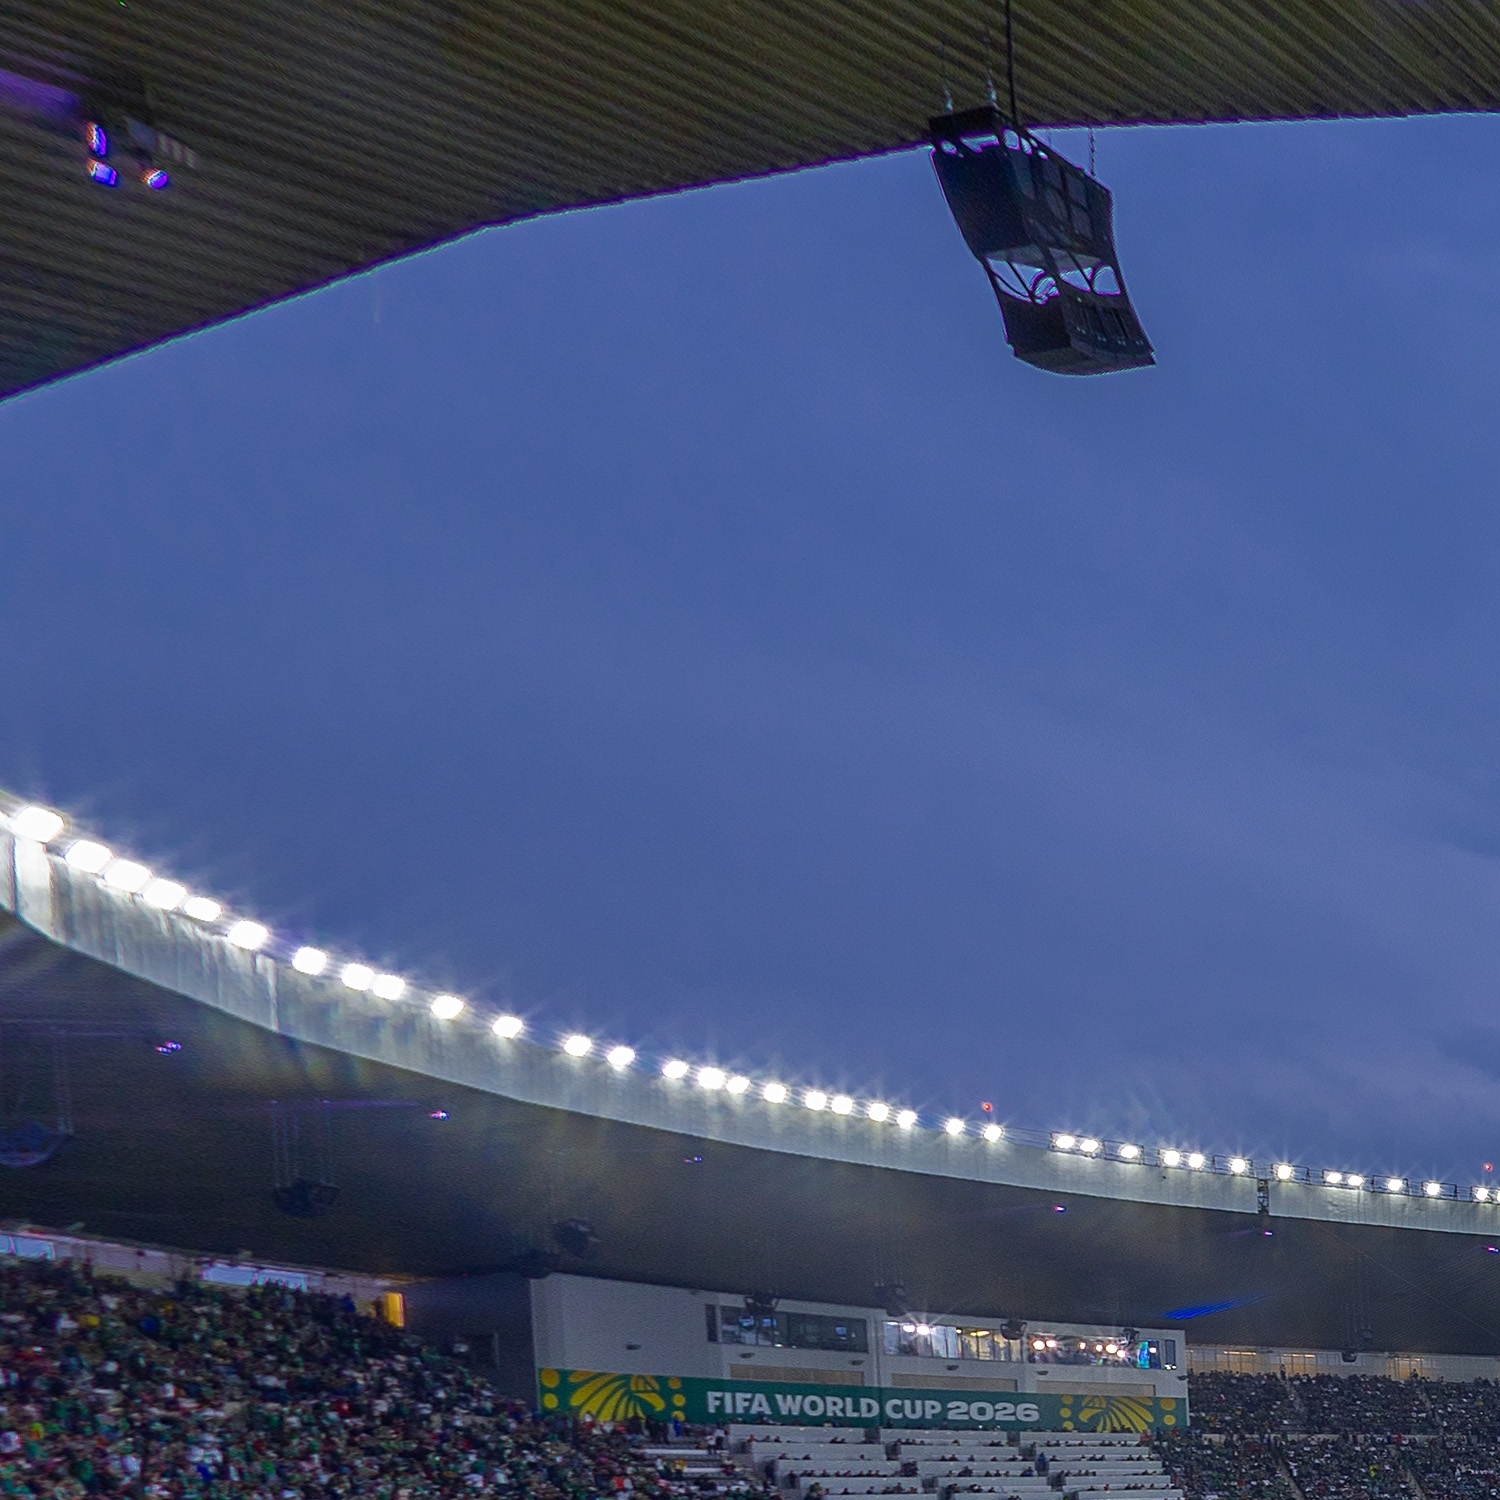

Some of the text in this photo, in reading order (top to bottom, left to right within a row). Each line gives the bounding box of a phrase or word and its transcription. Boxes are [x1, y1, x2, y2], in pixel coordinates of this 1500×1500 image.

[706, 1391, 1041, 1422] FIFA WORLD CUP 2026
